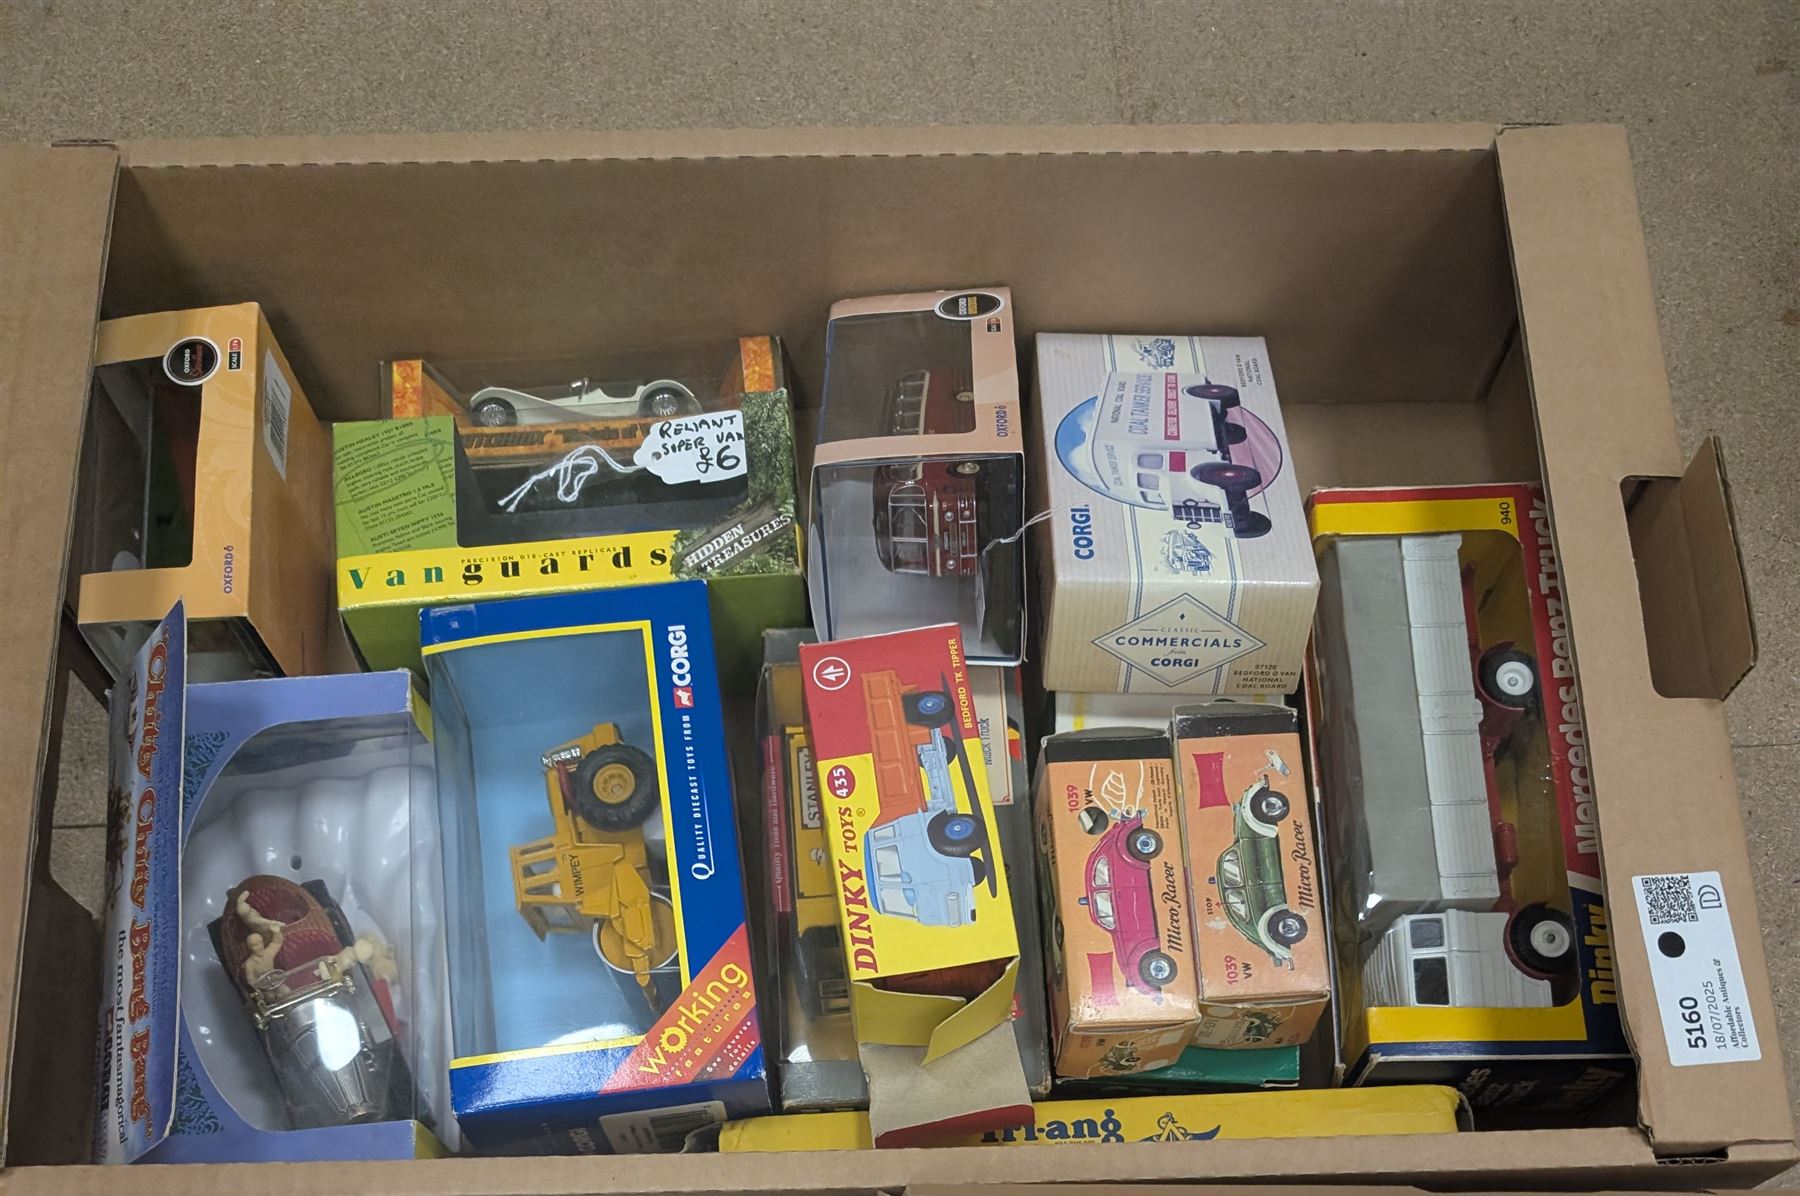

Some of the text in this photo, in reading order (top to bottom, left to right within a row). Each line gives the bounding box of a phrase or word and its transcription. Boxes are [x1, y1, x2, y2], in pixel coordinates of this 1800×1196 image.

[997, 409, 1009, 438] OXFORD
[1111, 402, 1123, 425] NATIONAL
[1128, 374, 1153, 436] COAL TANKER SERVICE
[659, 414, 738, 440] RELIANT
[1070, 507, 1095, 561] CORGI
[1501, 500, 1512, 526] 940
[461, 546, 618, 565] PRECISION DIE-CAST REPLICAS
[683, 522, 746, 568] HIDDEN
[700, 513, 793, 573] TREASURES
[223, 551, 234, 594] OXFORD
[350, 546, 668, 591] Vanguards
[668, 624, 692, 687] CORGI
[1115, 636, 1242, 648] COMMERCIALS
[1150, 658, 1199, 668] CORGI
[947, 637, 973, 730] BEDFORD TK TIPPER
[1233, 670, 1271, 678] BEDFORD
[682, 714, 692, 741] FROM
[685, 746, 696, 771] TOYS
[1558, 684, 1598, 855] Mercedes
[688, 775, 702, 818] DIECAST
[1066, 783, 1094, 814] 1039 VW
[569, 853, 585, 897] WIMPEY
[832, 767, 879, 974] DINKY TOYS 435
[1290, 819, 1315, 909] Micro Racer
[128, 787, 157, 1026] Chitty Bang
[1162, 861, 1183, 952] Micro Racer
[1206, 896, 1214, 916] STOP
[118, 929, 127, 961] the
[115, 964, 125, 1005] most
[1225, 954, 1252, 986] 1039 VW
[1719, 967, 1734, 1004] Antiques
[637, 962, 750, 1075] working
[1679, 996, 1707, 1049] 5160
[1702, 980, 1727, 1051] 18/07/2025
[1725, 1004, 1740, 1050] Affordable
[1733, 1006, 1749, 1049] Collectors
[706, 1019, 752, 1073] See reverse
[728, 1043, 744, 1059] for
[728, 1039, 757, 1073] details
